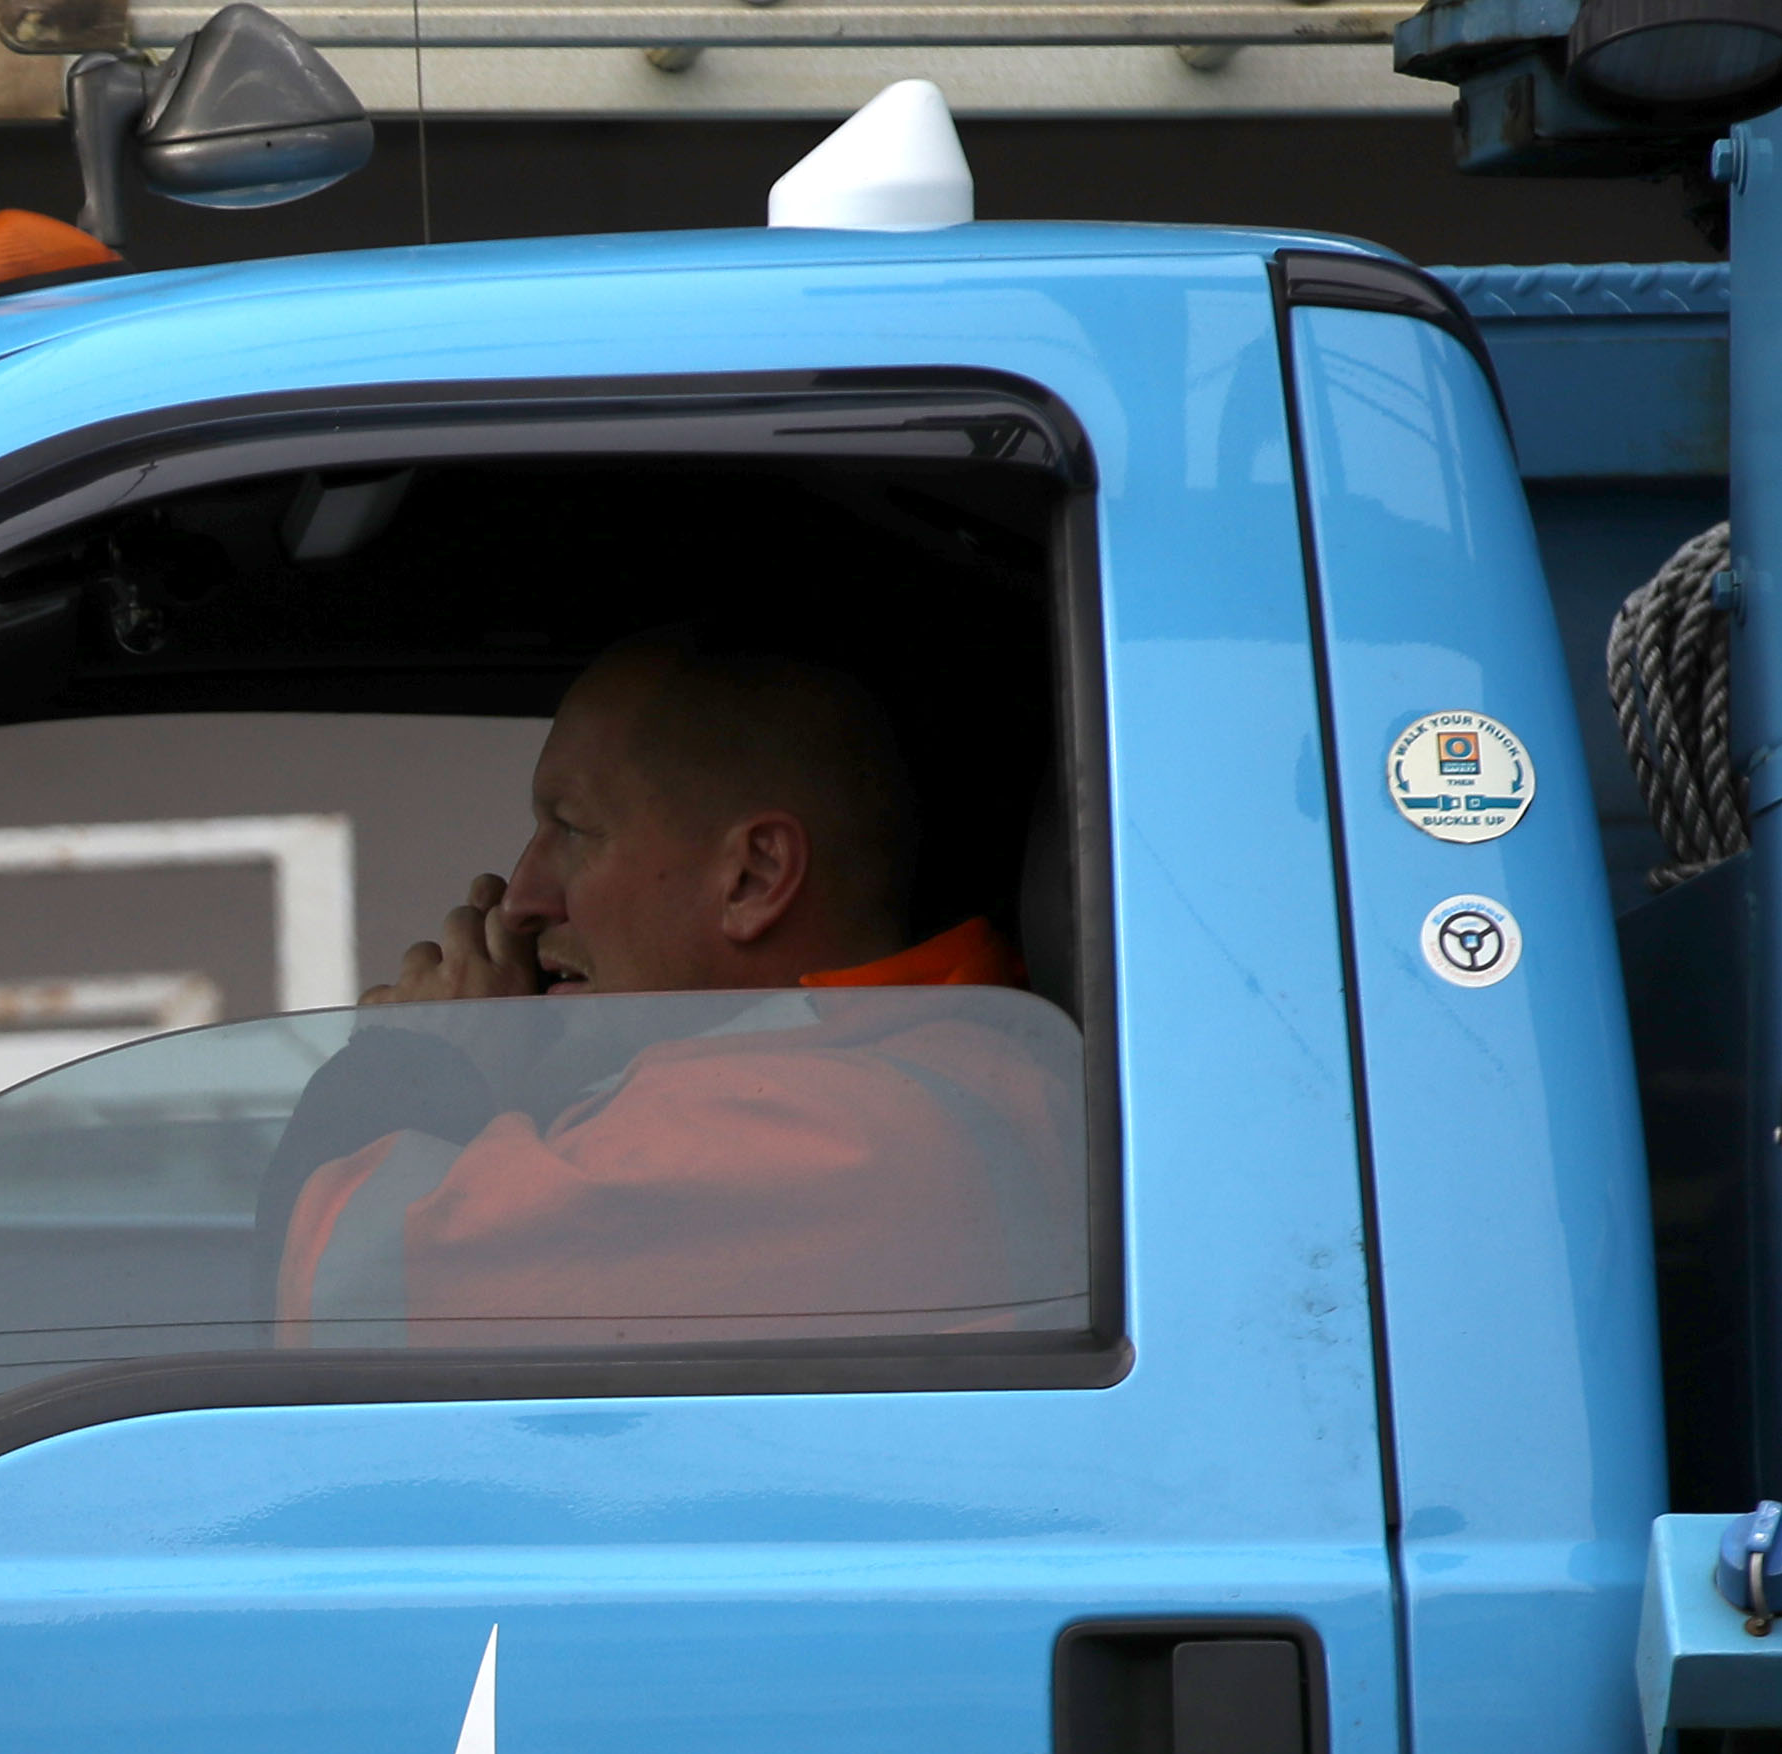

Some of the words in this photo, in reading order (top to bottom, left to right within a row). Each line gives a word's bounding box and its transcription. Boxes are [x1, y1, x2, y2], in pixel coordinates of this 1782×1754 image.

[1395, 723, 1428, 756] WALK
[1431, 715, 1474, 728] YOUR
[1478, 719, 1522, 758] TRUCK
[1423, 816, 1482, 826] BUCKLE
[1485, 816, 1506, 826] UP
